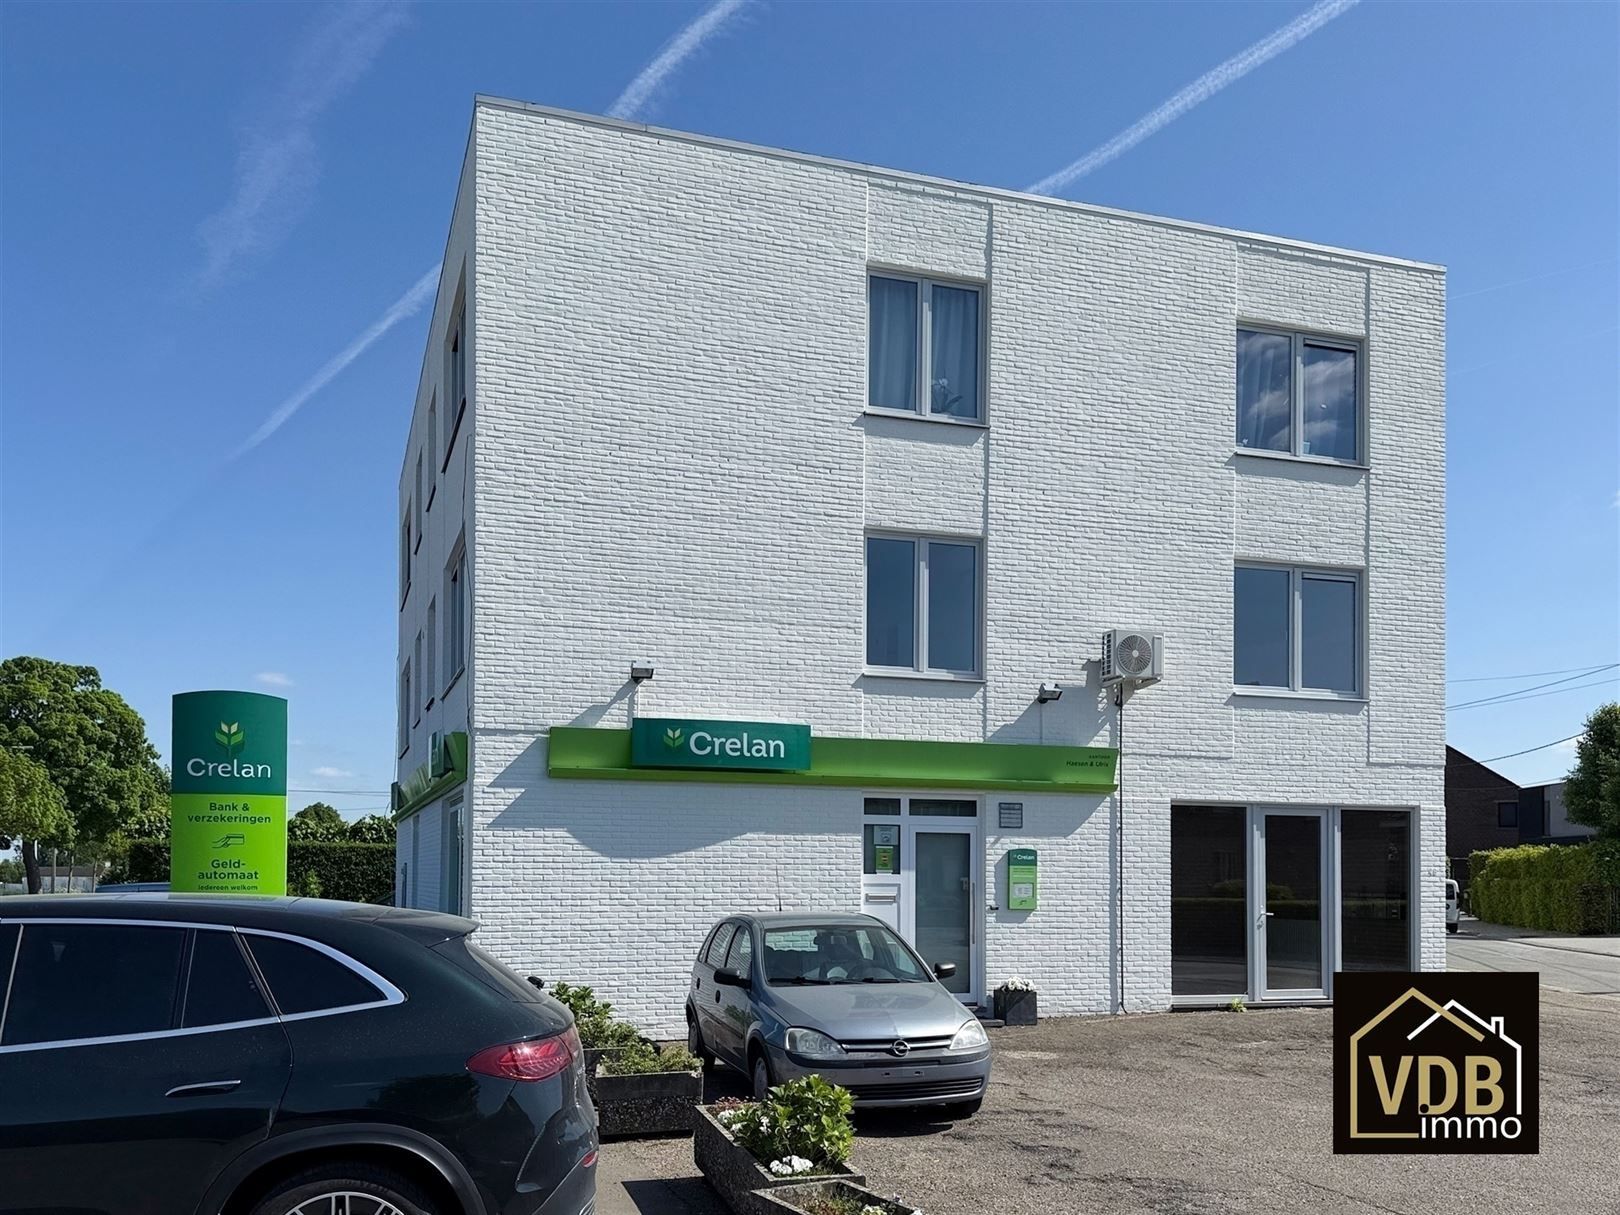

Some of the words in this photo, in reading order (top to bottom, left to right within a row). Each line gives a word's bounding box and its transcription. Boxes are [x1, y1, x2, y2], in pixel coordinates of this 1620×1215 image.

[689, 731, 785, 758] Crelan
[186, 758, 271, 779] Crelan
[209, 802, 239, 812] Bank
[241, 802, 250, 812] &
[187, 814, 271, 825] verzekeringen
[211, 859, 246, 869] Geld-
[198, 871, 259, 880] automaat
